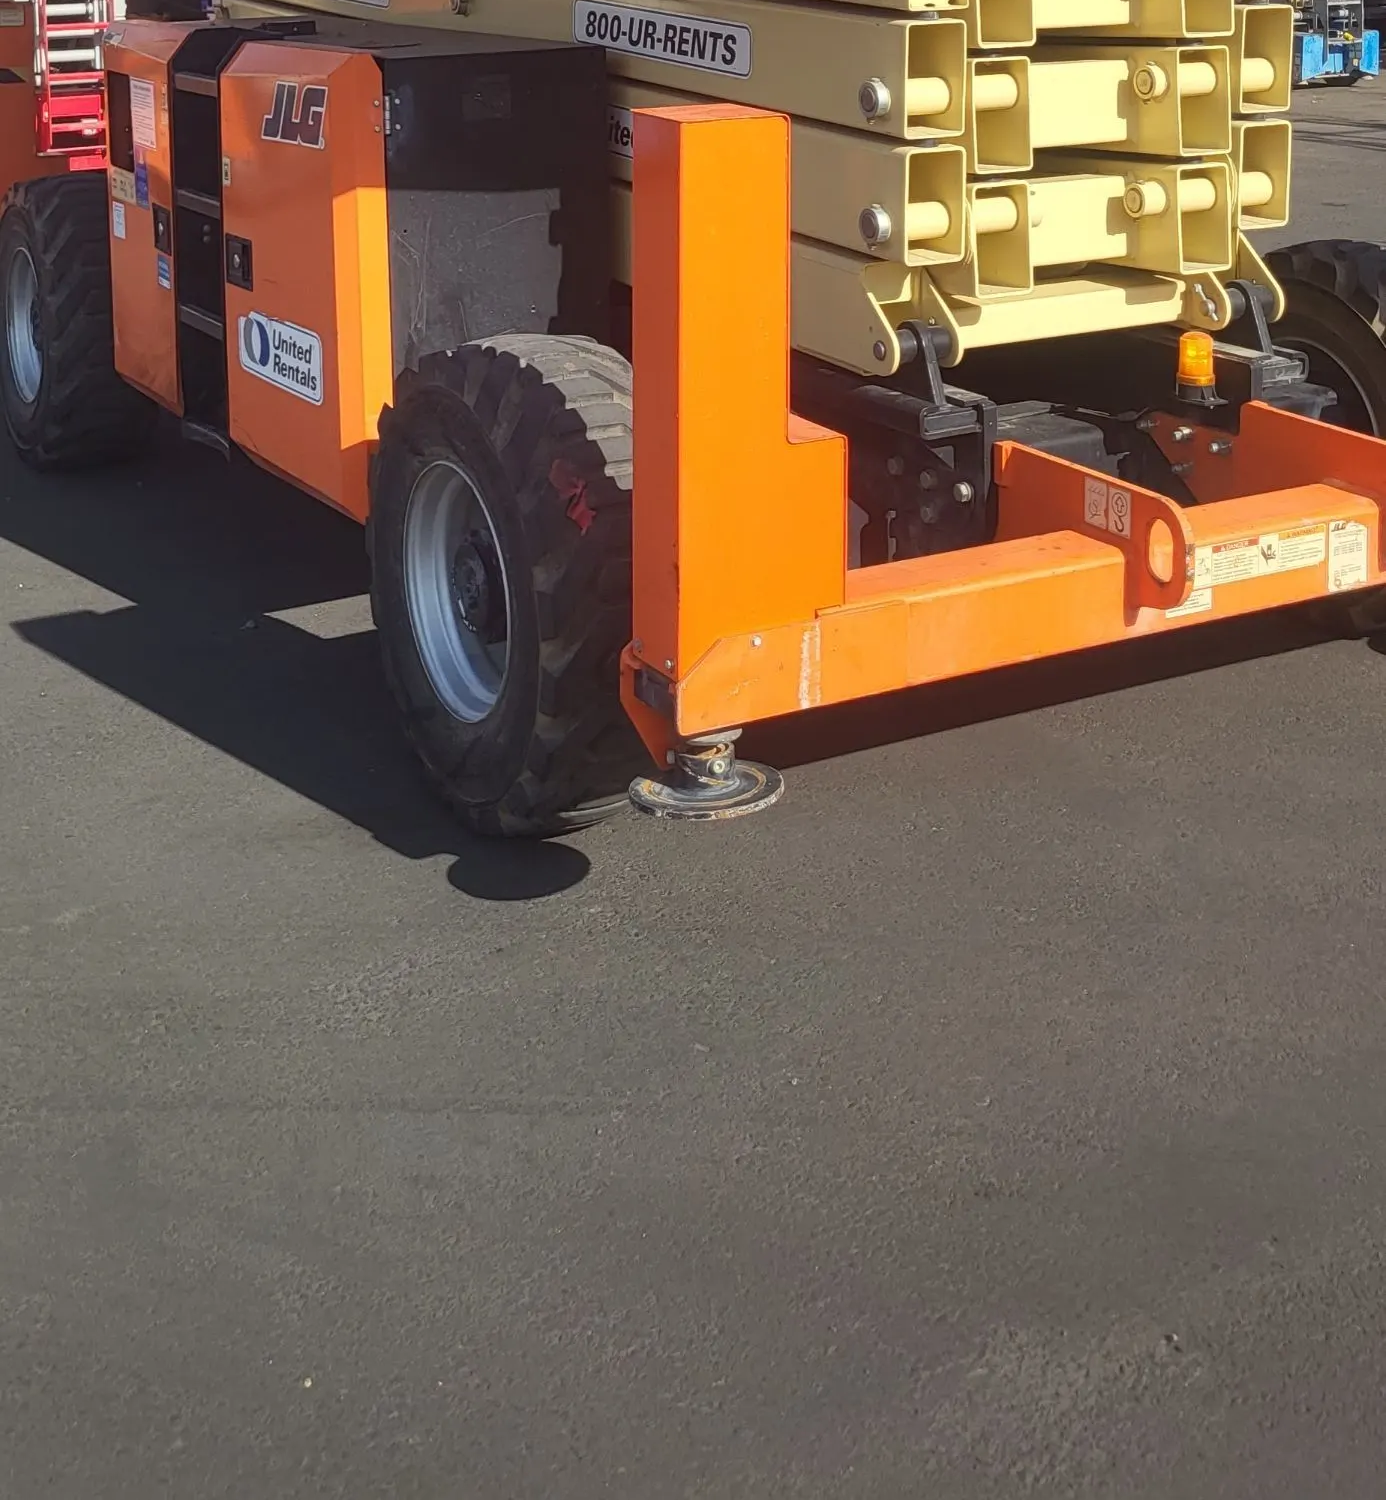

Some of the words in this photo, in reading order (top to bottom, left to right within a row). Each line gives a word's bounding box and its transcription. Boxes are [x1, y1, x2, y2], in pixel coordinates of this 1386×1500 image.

[585, 10, 737, 66] 800-UR-RENTS
[262, 82, 327, 147] JLG
[272, 329, 312, 365] United
[272, 353, 317, 391] Rentals
